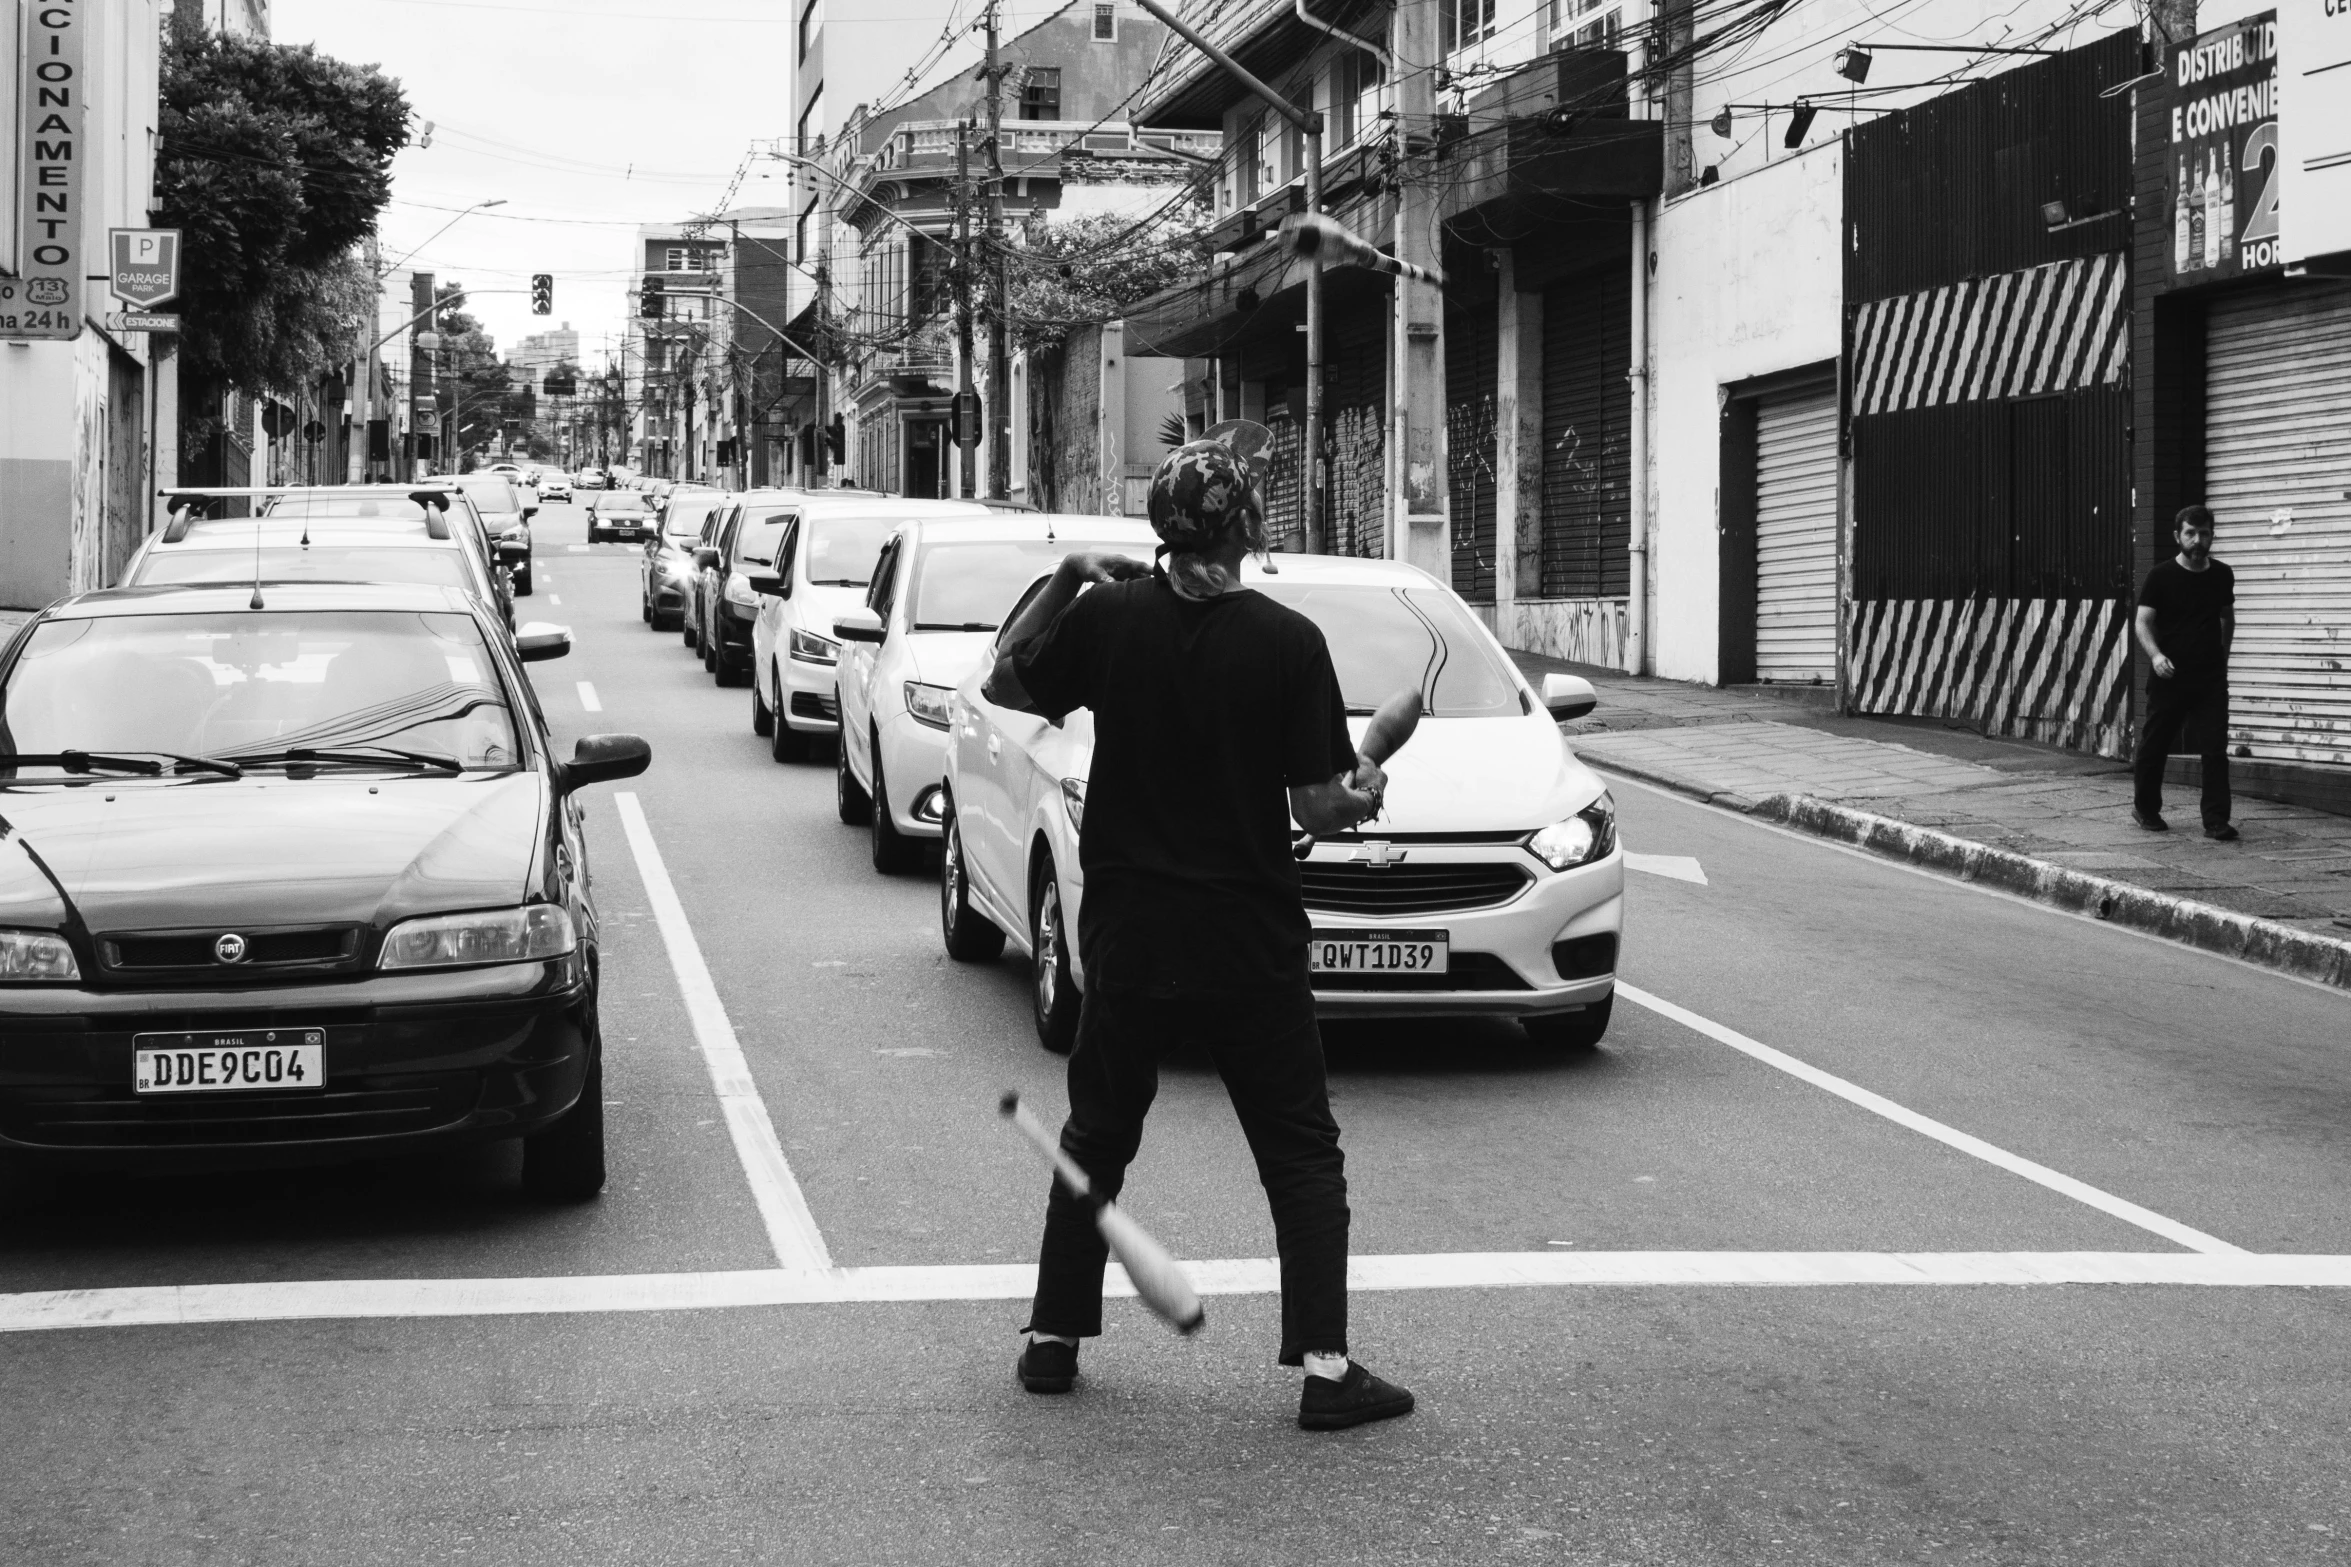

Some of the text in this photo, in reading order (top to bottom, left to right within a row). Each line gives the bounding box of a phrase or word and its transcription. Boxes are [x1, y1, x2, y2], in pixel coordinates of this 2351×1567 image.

[2172, 106, 2182, 143] E
[33, 0, 73, 266] CIONAMENTO
[139, 238, 154, 257] P
[118, 272, 170, 285] GARAGE
[35, 281, 59, 292] 13
[132, 285, 154, 293] PARK
[24, 310, 52, 329] 24
[57, 311, 70, 329] h
[125, 317, 176, 328] ESTACIONE
[219, 943, 240, 954] FIAT
[1323, 943, 1434, 969] QWT1D39
[1312, 961, 1320, 969] BR
[214, 1038, 244, 1046] BRASIL
[153, 1050, 305, 1086] DDE9C04
[139, 1078, 150, 1089] BR
